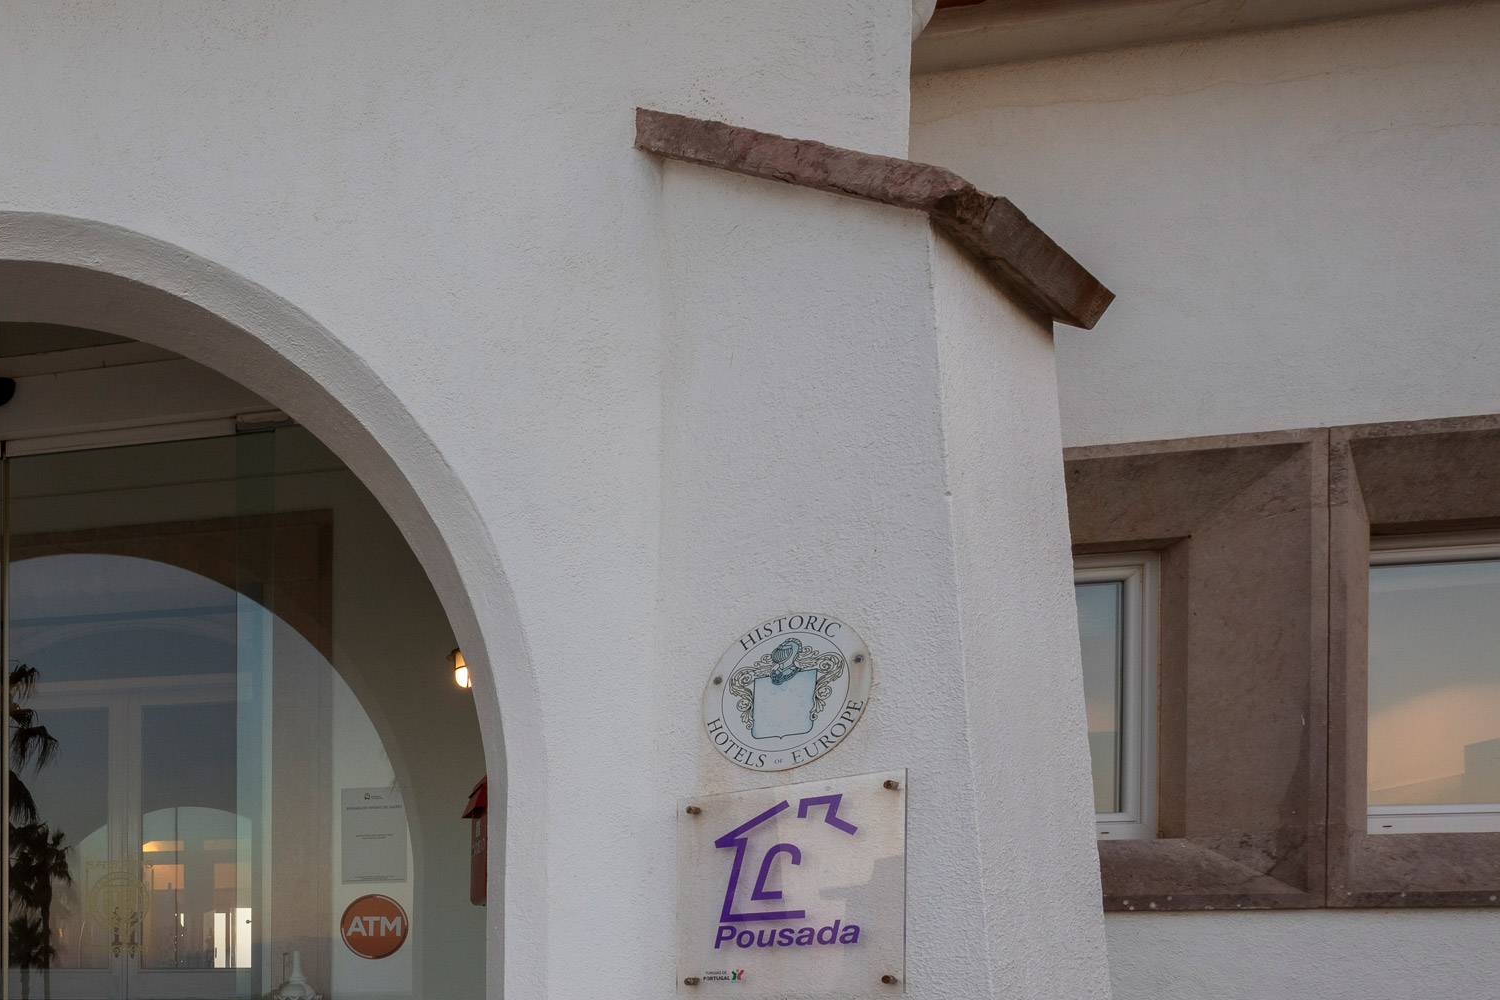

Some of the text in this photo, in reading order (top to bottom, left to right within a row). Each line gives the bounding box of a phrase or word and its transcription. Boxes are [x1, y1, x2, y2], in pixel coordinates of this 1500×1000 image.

[739, 615, 842, 651] HISTORIC
[707, 718, 767, 768] HOTELS
[791, 700, 864, 765] EUROPE
[346, 916, 402, 937] ATM
[714, 920, 861, 949] Pousada
